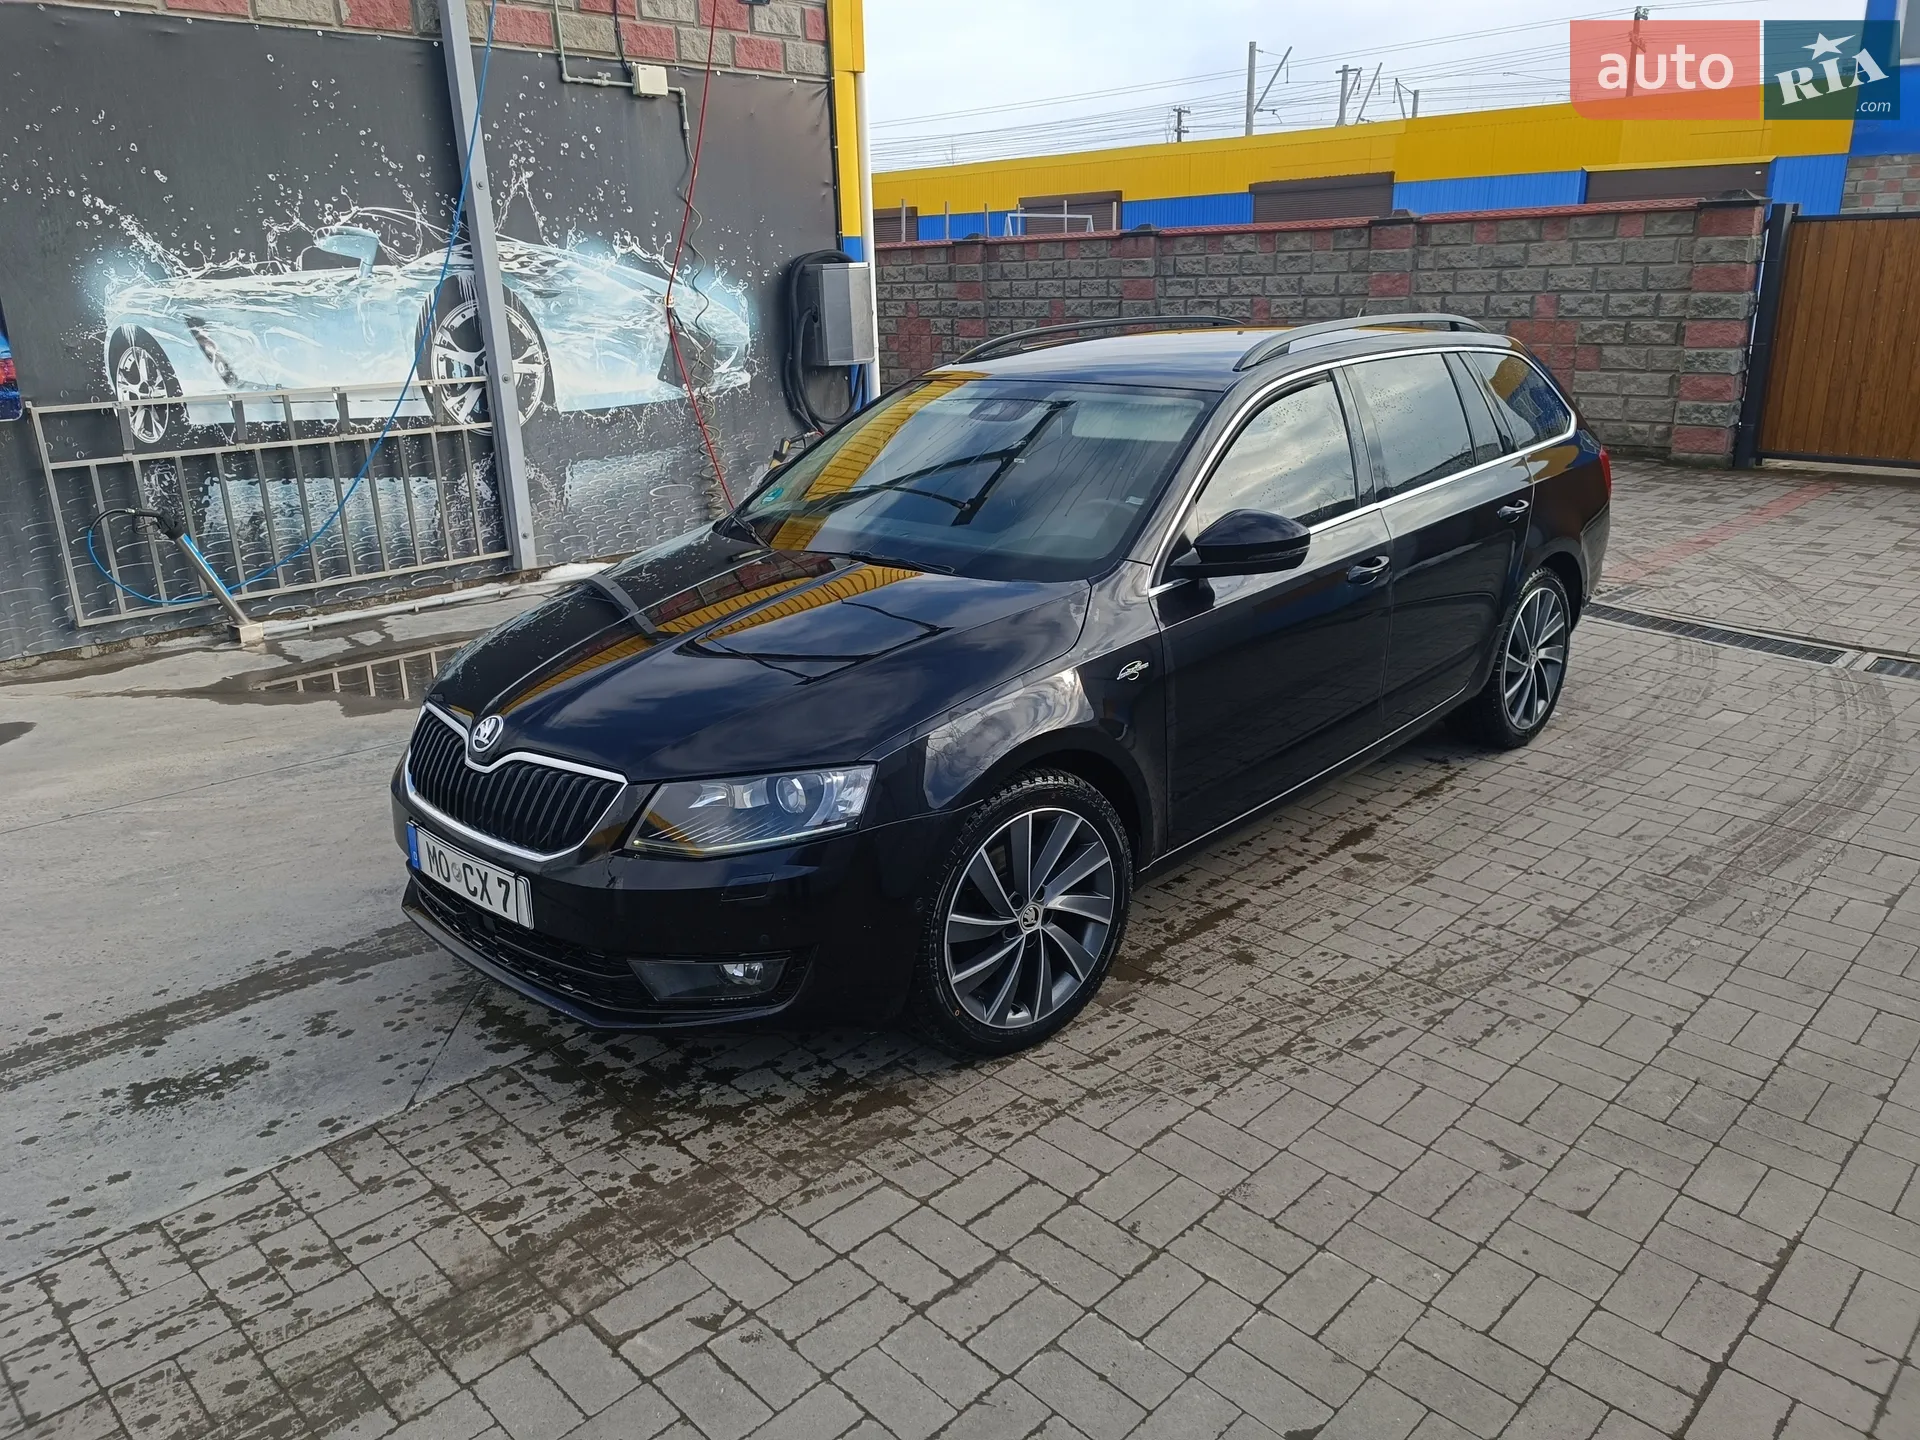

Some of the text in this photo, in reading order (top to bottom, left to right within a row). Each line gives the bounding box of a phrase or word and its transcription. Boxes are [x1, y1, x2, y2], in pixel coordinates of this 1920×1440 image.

[426, 841, 511, 913] MO CX 7
